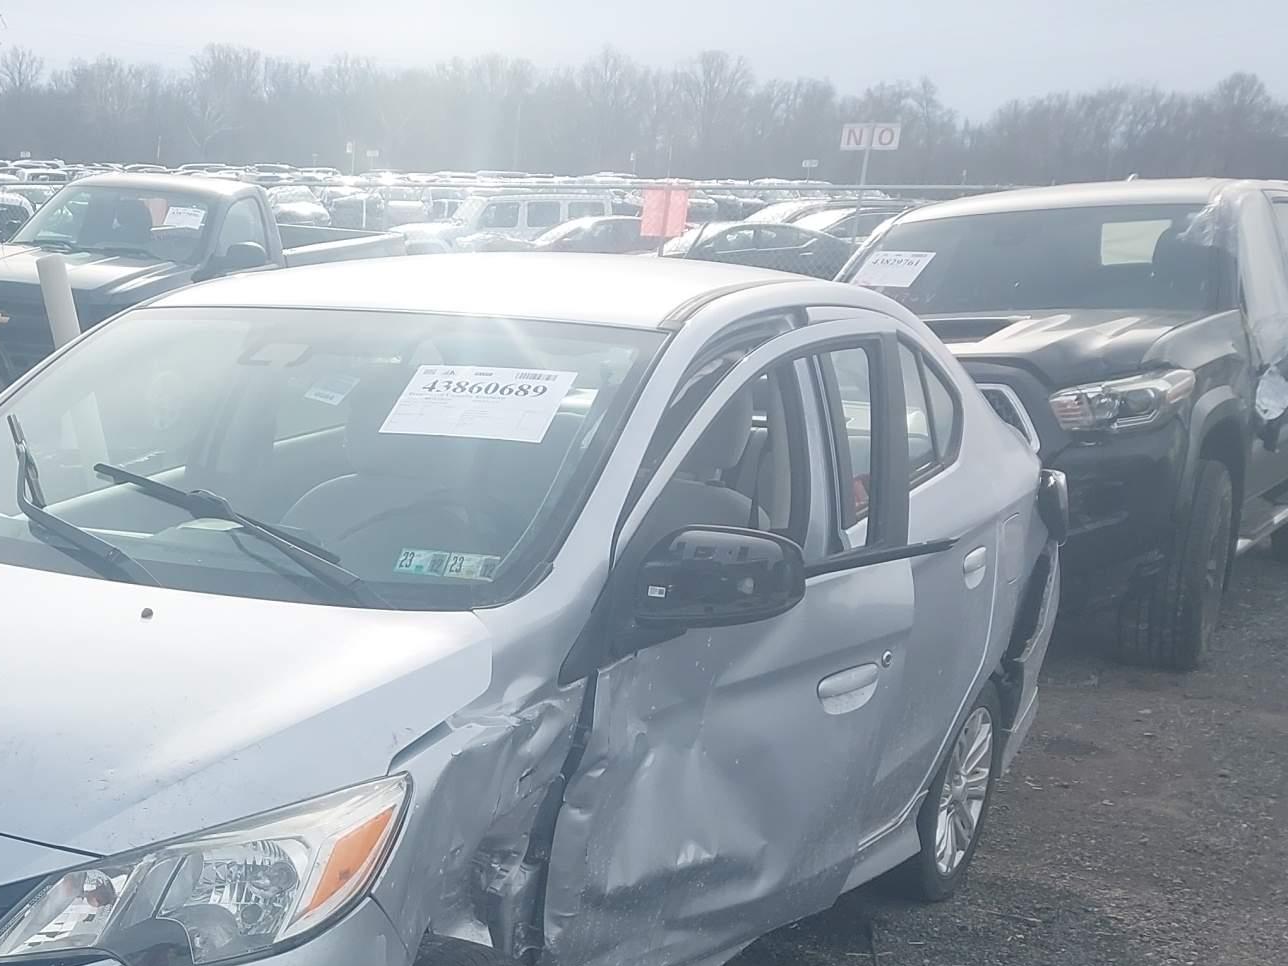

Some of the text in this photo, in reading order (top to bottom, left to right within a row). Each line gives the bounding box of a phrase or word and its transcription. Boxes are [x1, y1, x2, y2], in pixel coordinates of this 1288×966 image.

[847, 128, 894, 146] N O
[422, 379, 548, 398] 43860689
[398, 551, 415, 569] 23
[449, 555, 465, 573] 23
